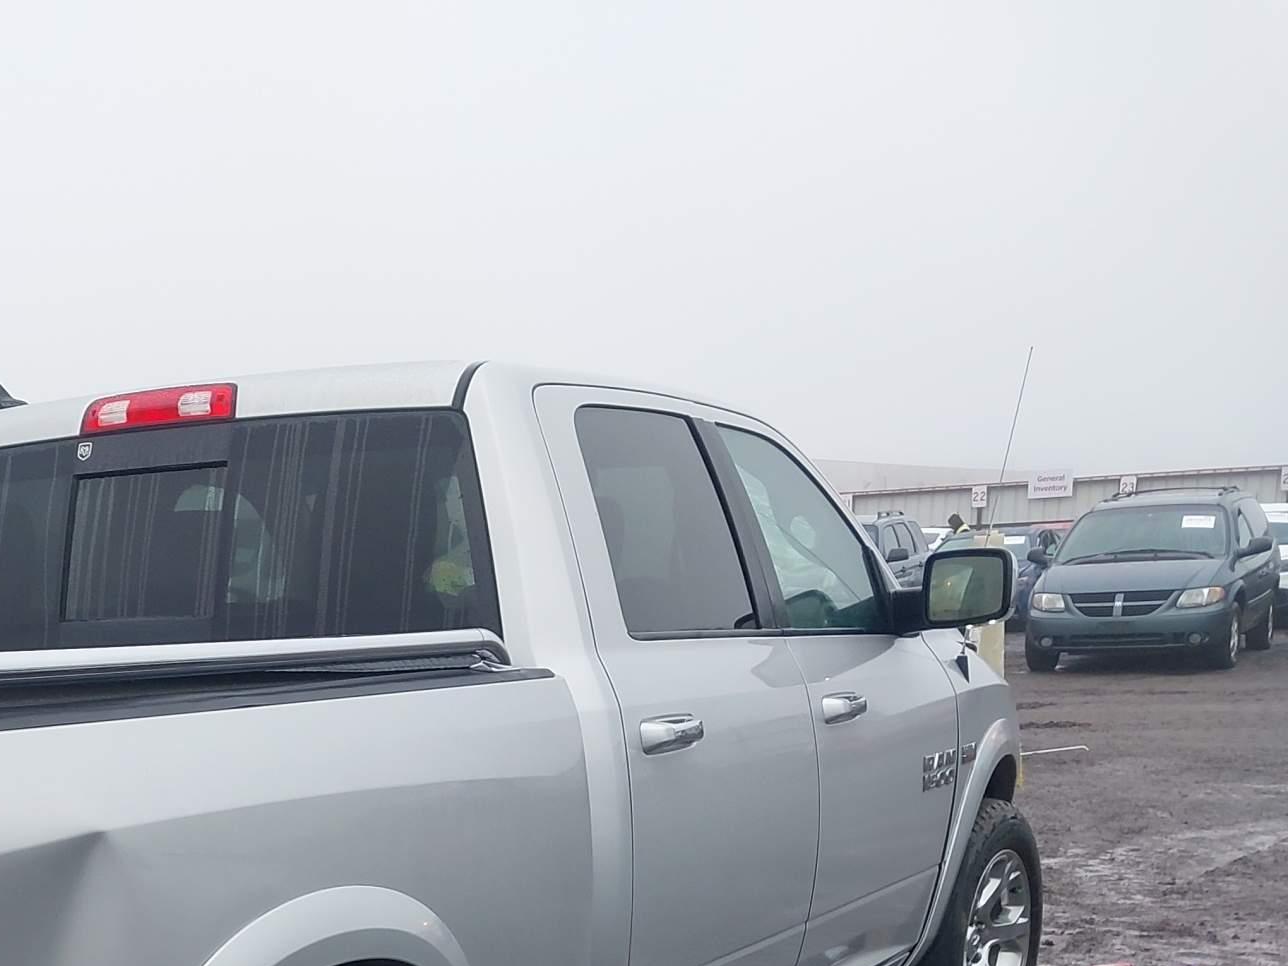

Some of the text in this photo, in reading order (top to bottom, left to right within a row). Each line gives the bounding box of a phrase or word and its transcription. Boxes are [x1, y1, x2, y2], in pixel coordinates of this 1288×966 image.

[1037, 473, 1066, 483] General
[1033, 485, 1068, 493] Inventory
[1121, 481, 1135, 494] 23
[972, 491, 986, 502] 22
[922, 748, 957, 773] RAM
